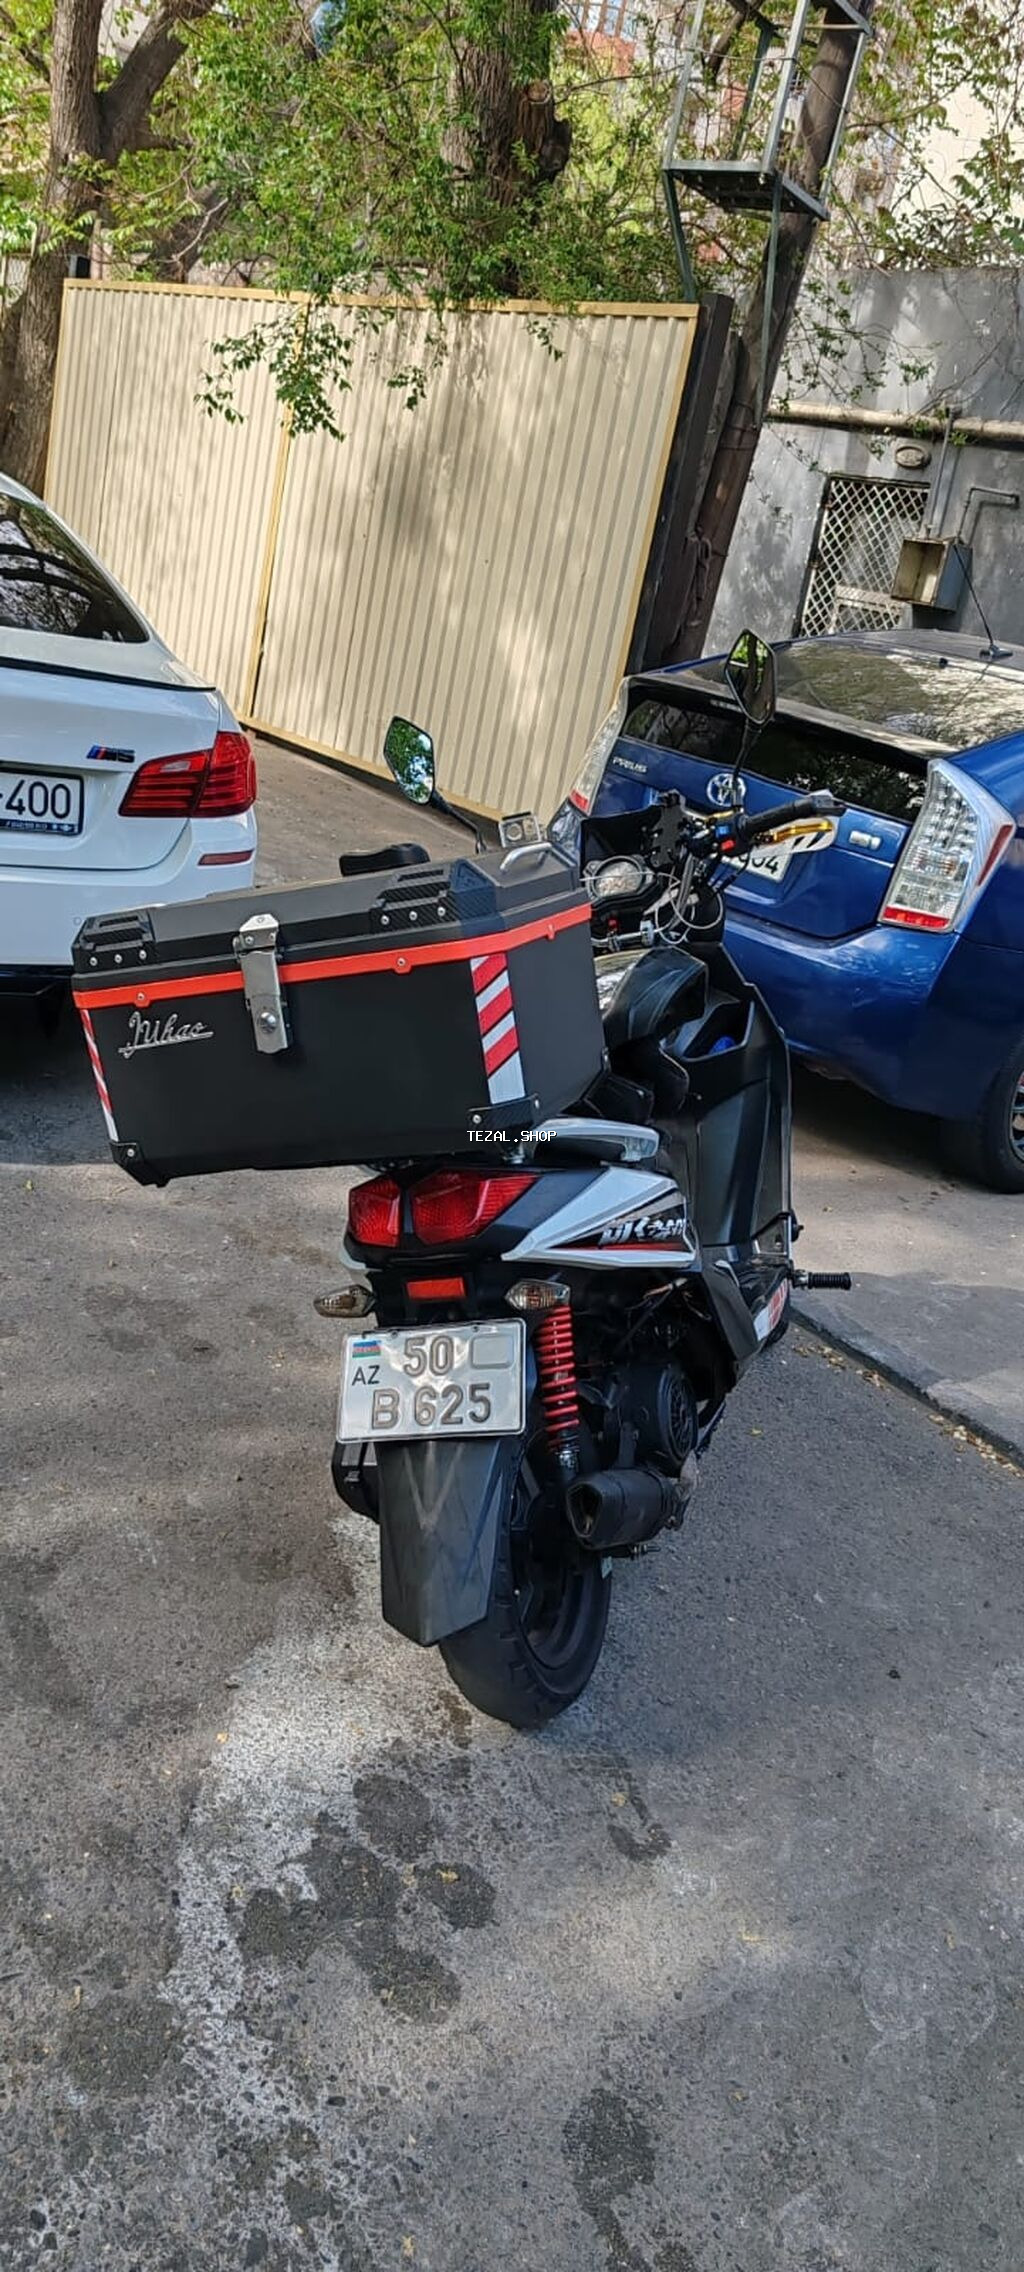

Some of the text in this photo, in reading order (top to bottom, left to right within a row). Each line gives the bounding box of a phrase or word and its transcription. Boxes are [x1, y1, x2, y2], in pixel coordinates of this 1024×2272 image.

[352, 1365, 380, 1386] AZ
[403, 1335, 454, 1377] 50
[372, 1383, 491, 1430] B 625
